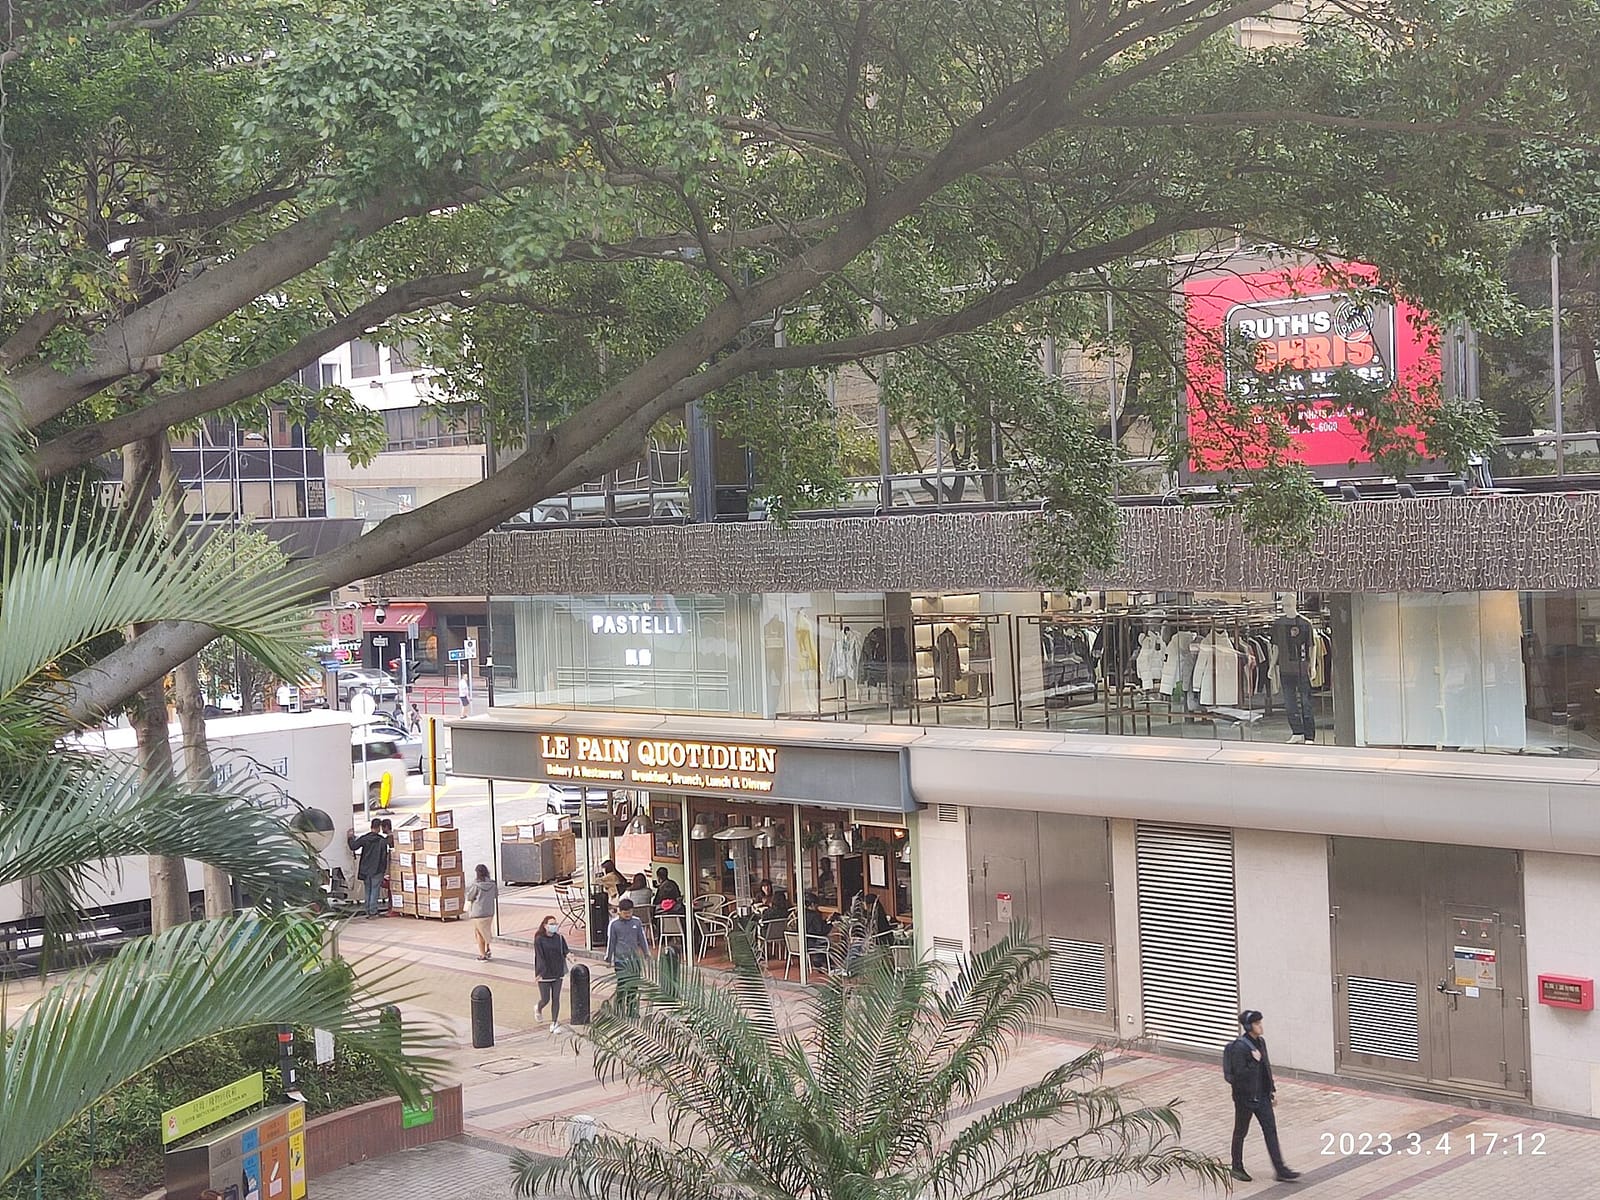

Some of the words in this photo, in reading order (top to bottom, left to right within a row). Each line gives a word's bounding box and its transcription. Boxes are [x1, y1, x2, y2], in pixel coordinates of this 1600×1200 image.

[1240, 312, 1331, 339] RUTH'S
[1254, 332, 1374, 373] CHRIS
[592, 615, 682, 634] PASTELLI
[541, 735, 570, 760] LE
[576, 737, 631, 763] PAIN
[637, 740, 777, 773] QUOTIDIEN
[742, 777, 772, 791] Dinner
